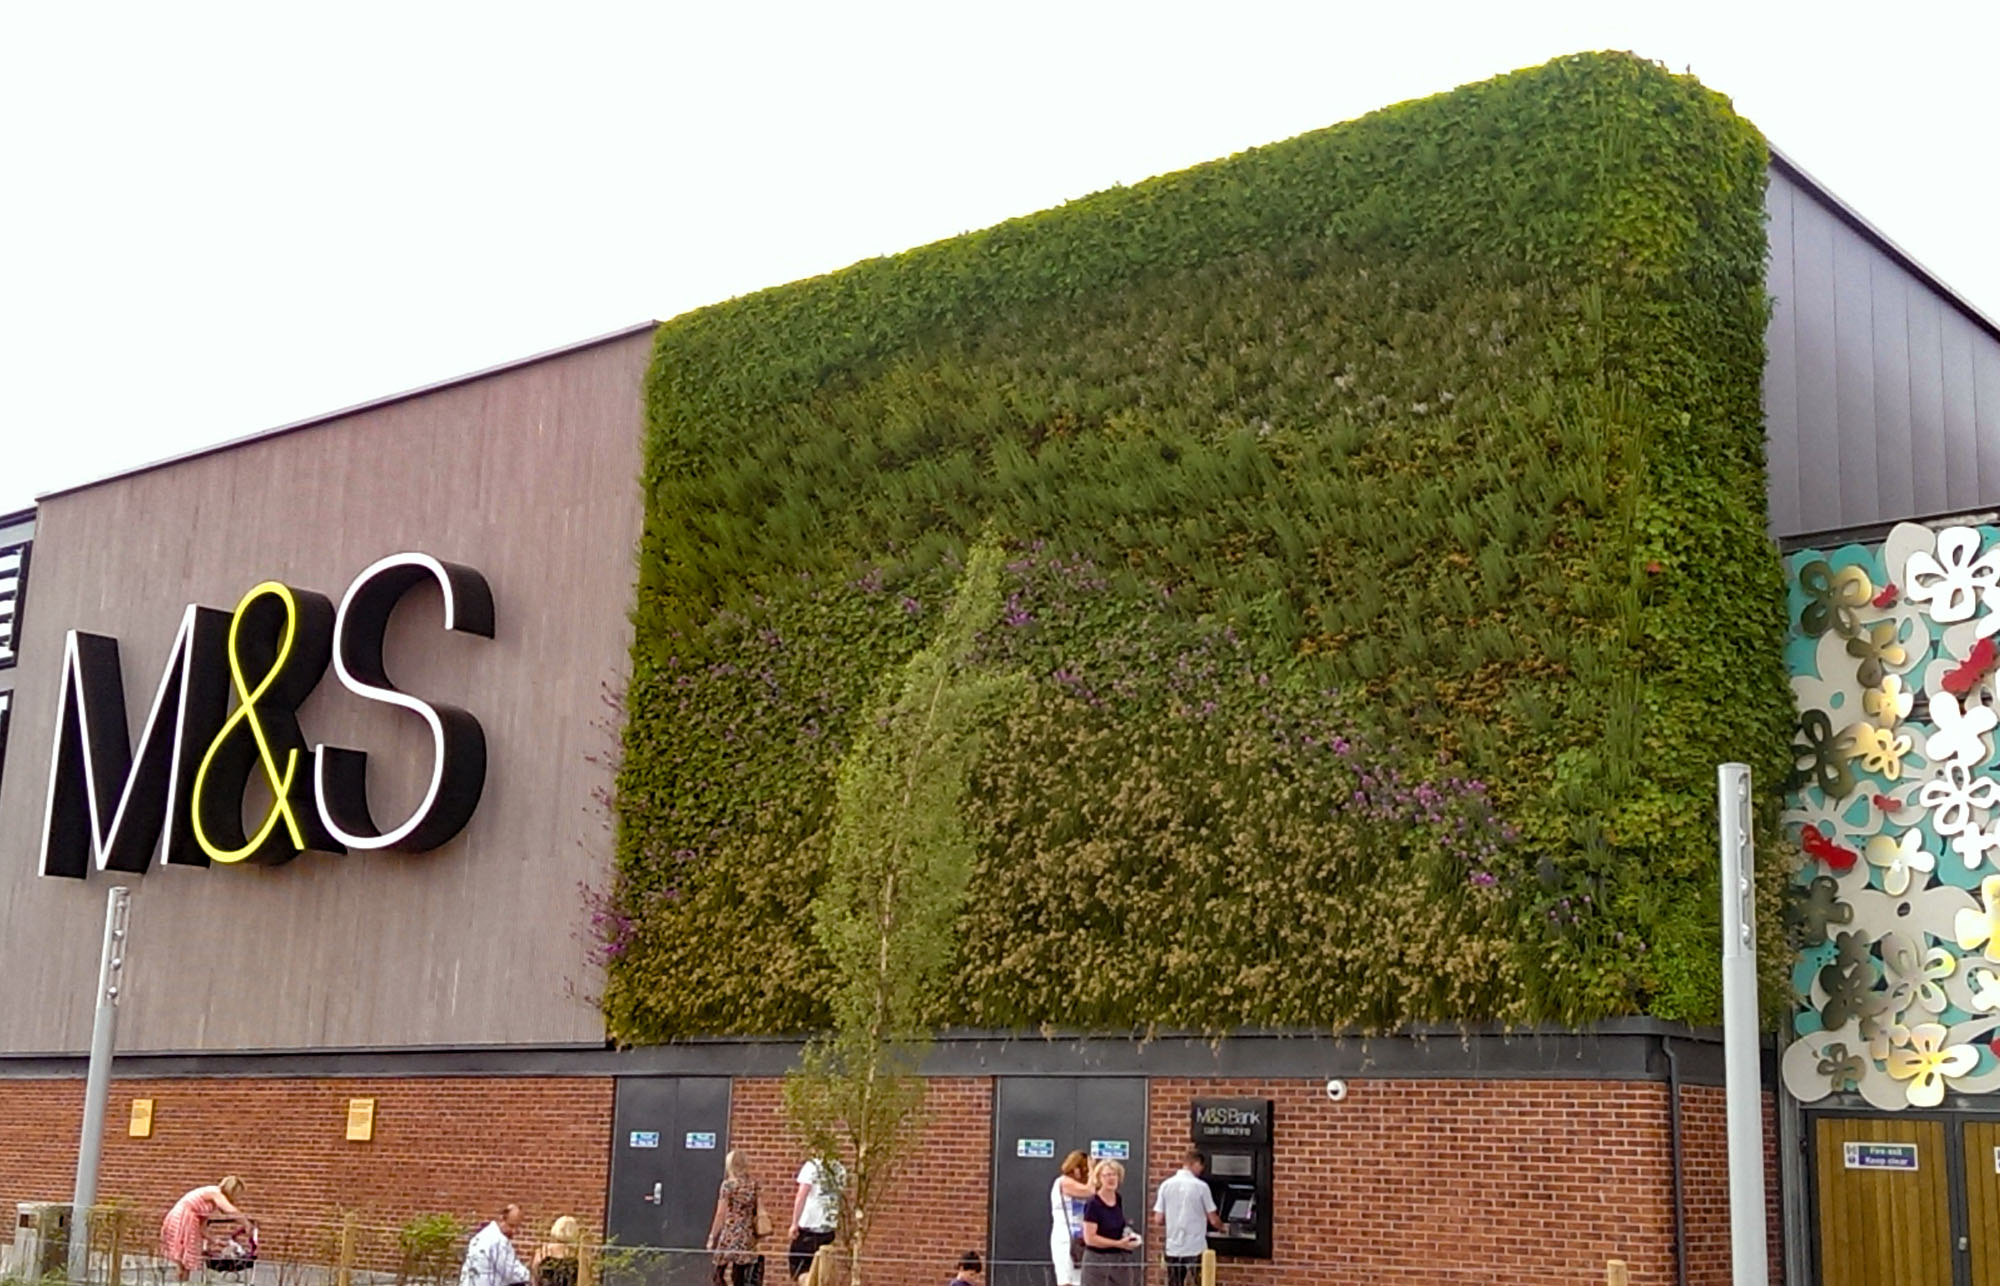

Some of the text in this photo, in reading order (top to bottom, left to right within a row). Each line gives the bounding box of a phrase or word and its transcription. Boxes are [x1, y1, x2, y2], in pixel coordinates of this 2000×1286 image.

[38, 551, 495, 879] M&S
[1196, 1107, 1260, 1124] M&S Bank
